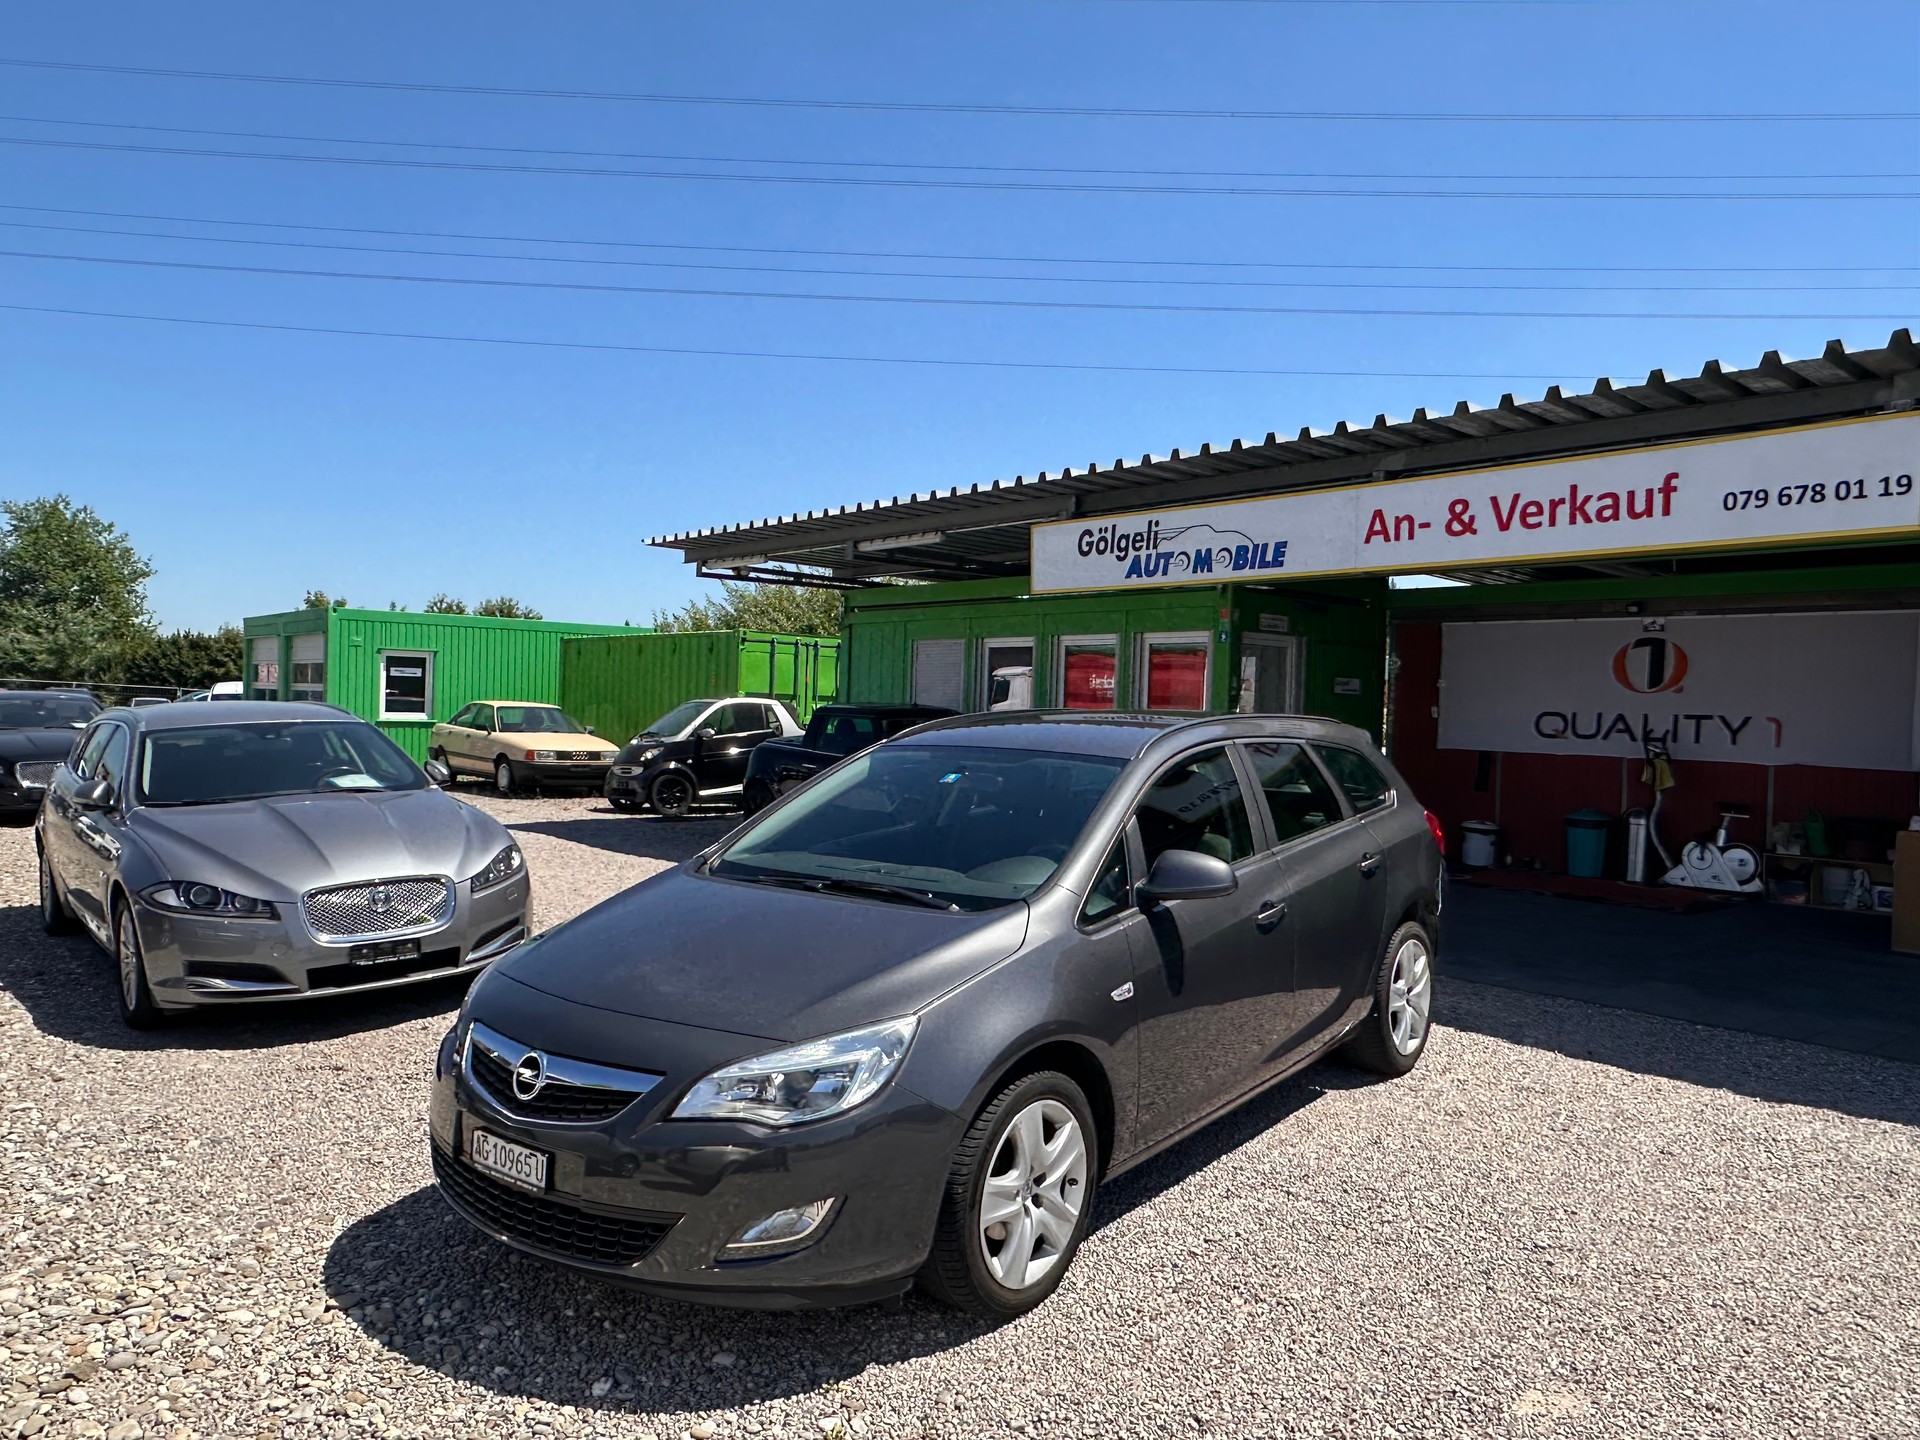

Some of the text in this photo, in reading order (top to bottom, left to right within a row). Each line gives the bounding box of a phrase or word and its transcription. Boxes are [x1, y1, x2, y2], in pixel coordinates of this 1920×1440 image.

[1363, 472, 1680, 545] An- & Verkauf
[1723, 474, 1913, 511] 079 678 01 19
[1077, 519, 1160, 562] Gölgeli
[1533, 711, 1784, 748] QUALITY 1
